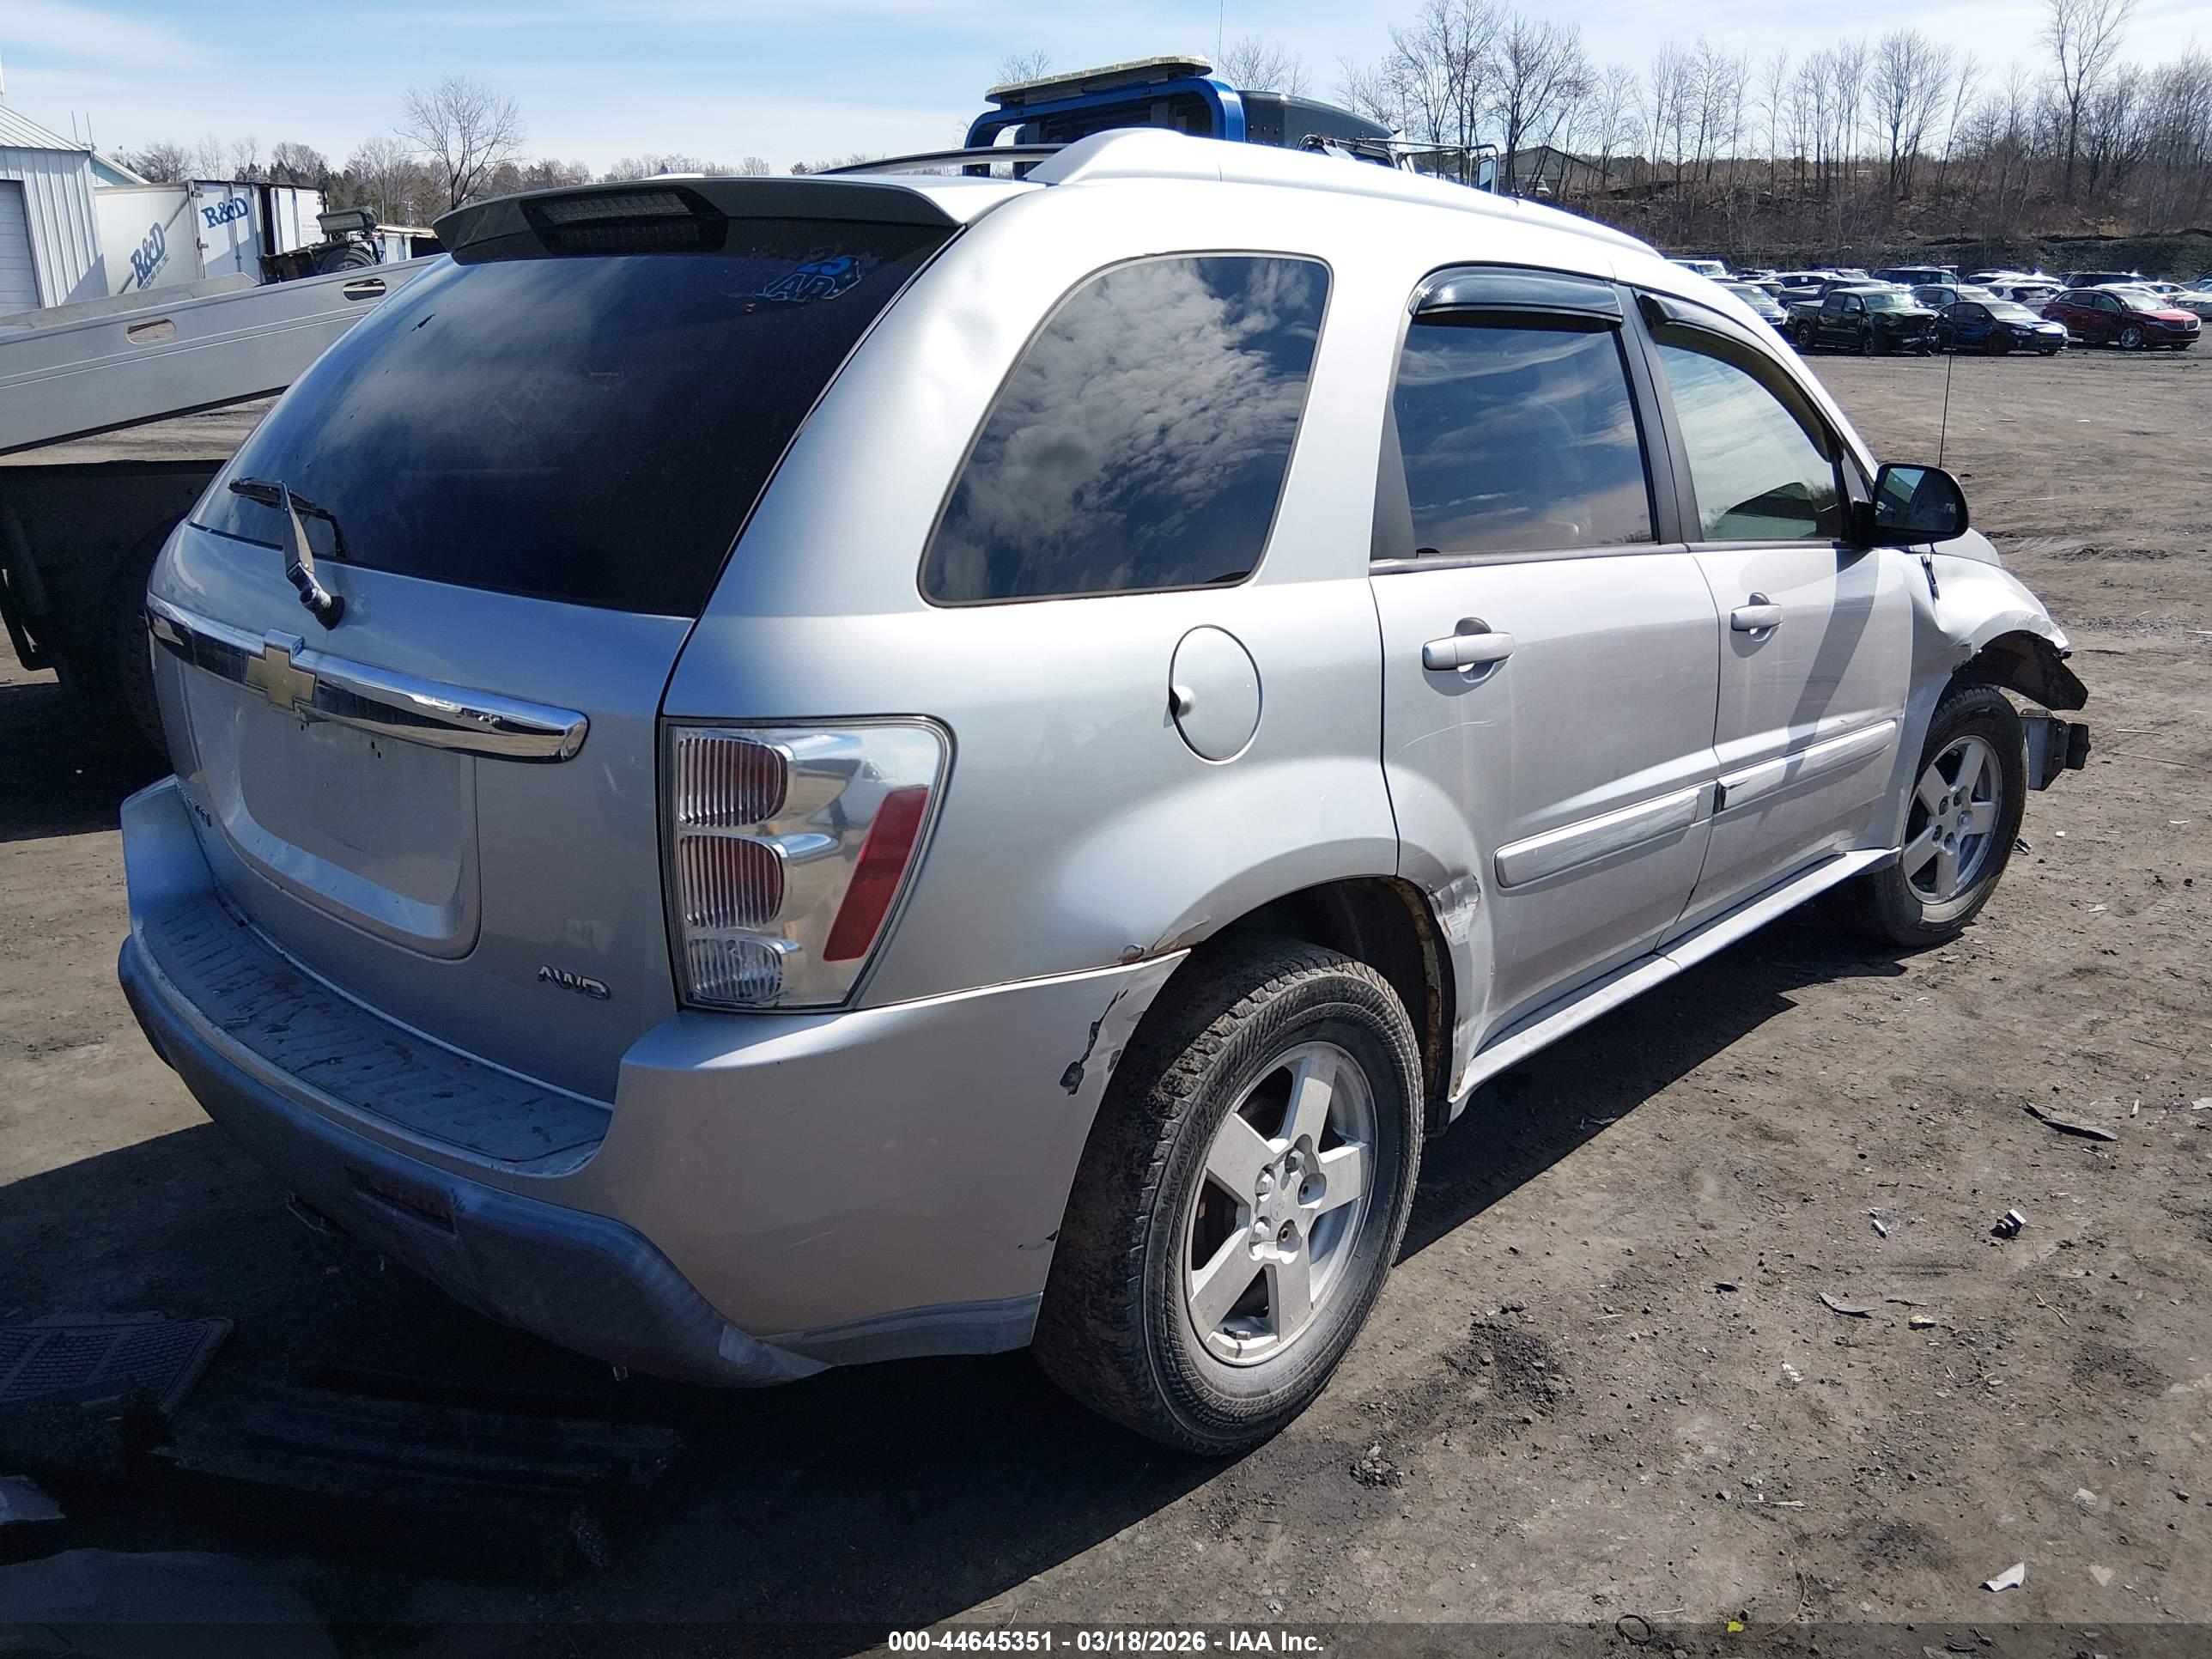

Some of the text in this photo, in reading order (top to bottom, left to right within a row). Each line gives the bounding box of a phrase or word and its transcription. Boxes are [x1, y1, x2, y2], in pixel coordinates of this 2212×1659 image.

[200, 197, 249, 228] R&D
[131, 222, 166, 289] R&D
[538, 964, 611, 1000] AWD
